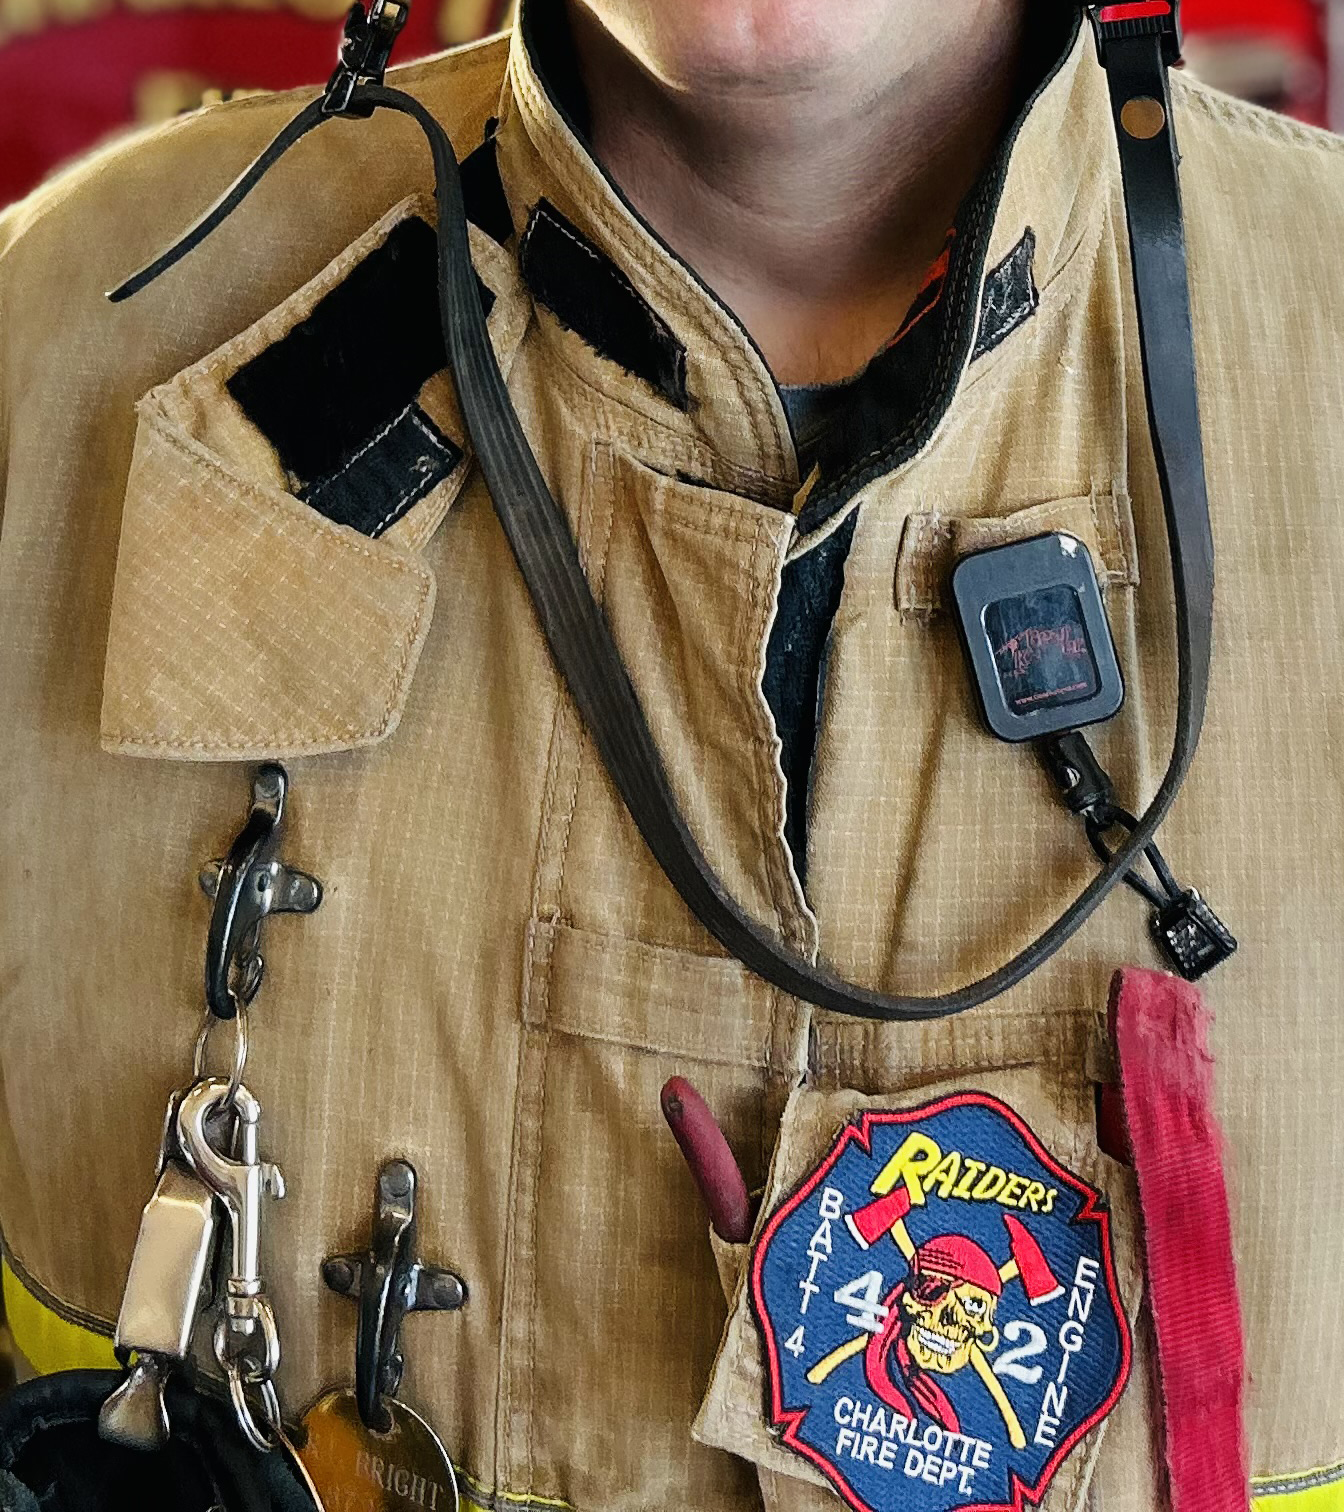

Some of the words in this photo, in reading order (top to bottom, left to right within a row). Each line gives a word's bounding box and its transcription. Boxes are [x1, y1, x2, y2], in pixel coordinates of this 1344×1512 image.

[798, 1186, 844, 1315] BATT
[784, 1324, 806, 1358] 4
[1033, 1255, 1100, 1448] ENGINE
[833, 1396, 993, 1470] CHARLOTTE
[835, 1427, 899, 1470] FIRE
